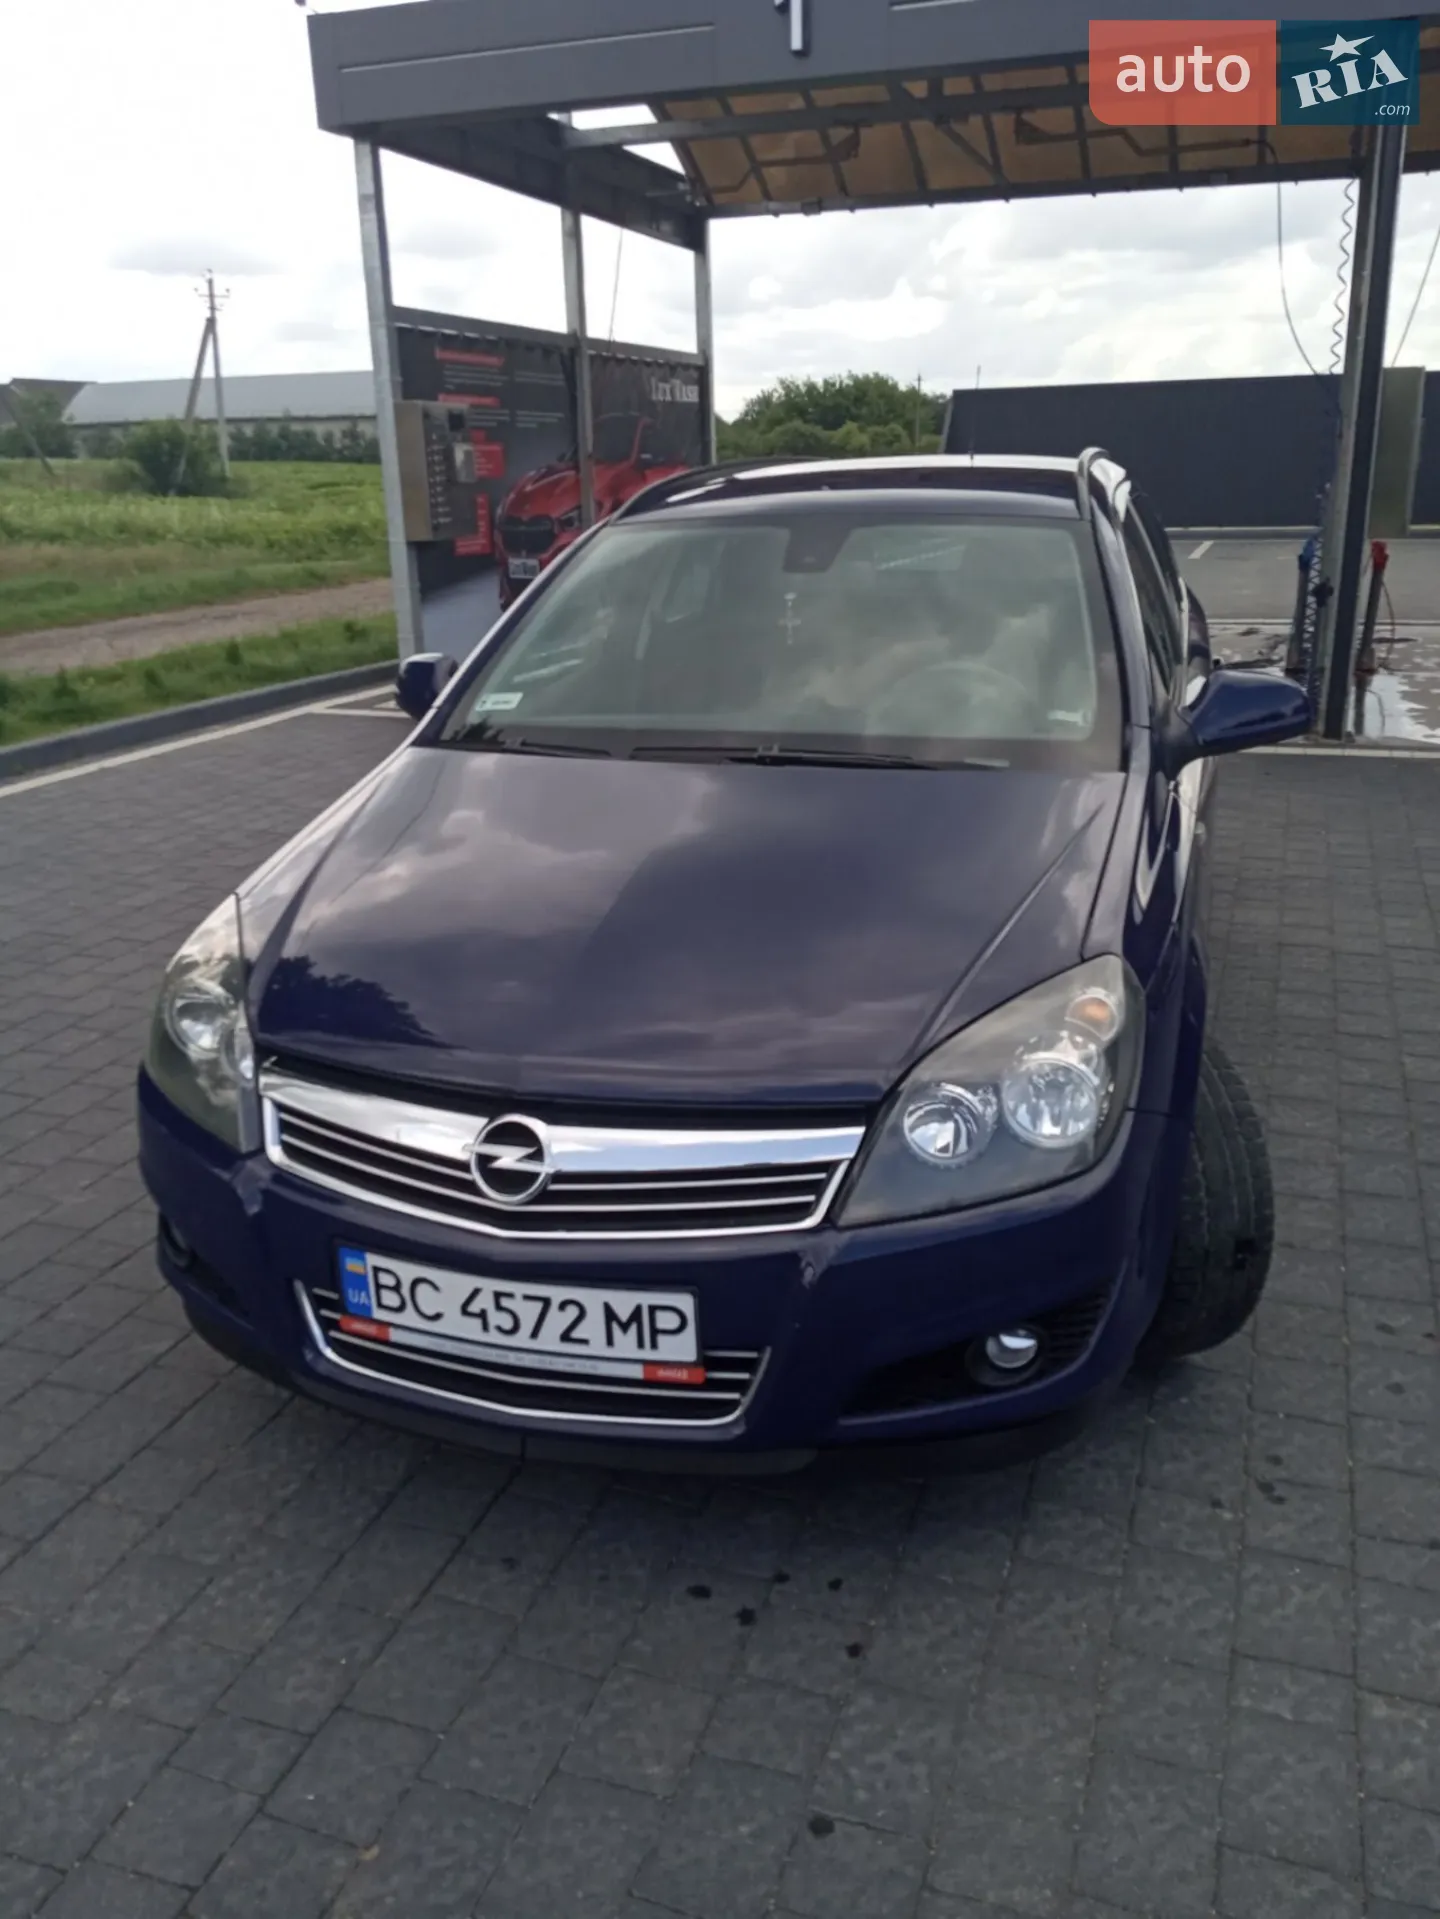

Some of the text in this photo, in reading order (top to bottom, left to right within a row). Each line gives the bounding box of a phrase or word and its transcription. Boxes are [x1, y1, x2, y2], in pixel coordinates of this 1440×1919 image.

[348, 1288, 371, 1306] UA
[371, 1266, 689, 1351] BC 4572 MP
